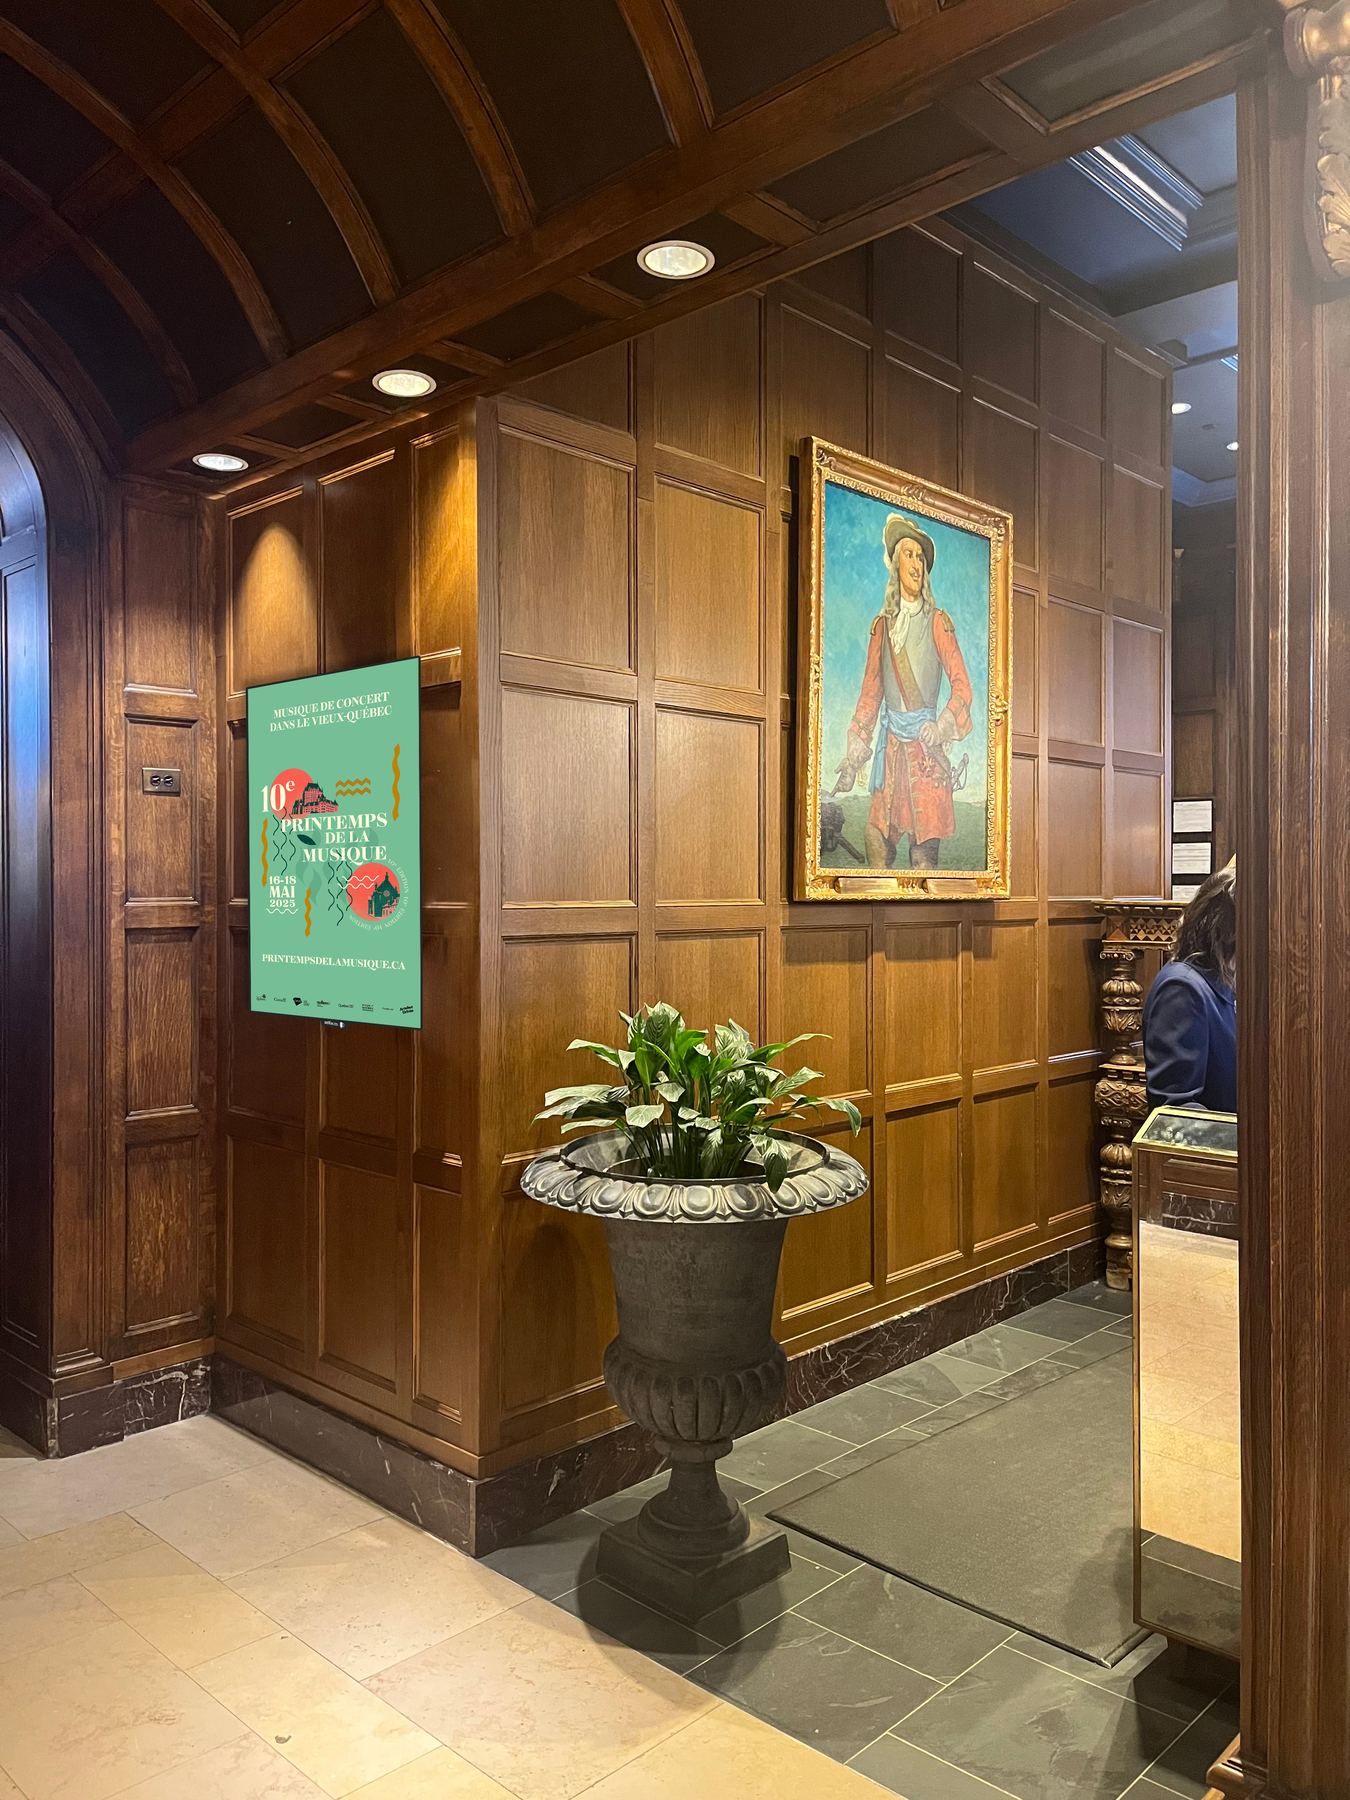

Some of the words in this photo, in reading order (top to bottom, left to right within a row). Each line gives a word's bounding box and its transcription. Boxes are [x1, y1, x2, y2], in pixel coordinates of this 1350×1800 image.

[273, 703, 318, 719] MUSIQUE
[320, 700, 335, 712] DE
[337, 691, 390, 708] CONCERT
[270, 720, 295, 732] DANS
[297, 718, 310, 728] LE
[313, 705, 392, 726] VIEUX-QUÉBEC
[282, 812, 388, 832] PRINTEMPS
[325, 832, 345, 843] DE
[349, 830, 369, 842] LA
[302, 846, 387, 865] MUSIQUE
[269, 876, 296, 885] 16-18
[269, 886, 295, 898] MAI
[269, 900, 296, 908] 2025
[262, 954, 406, 971] PRINTEMPSDELAMUSIQUE.CA
